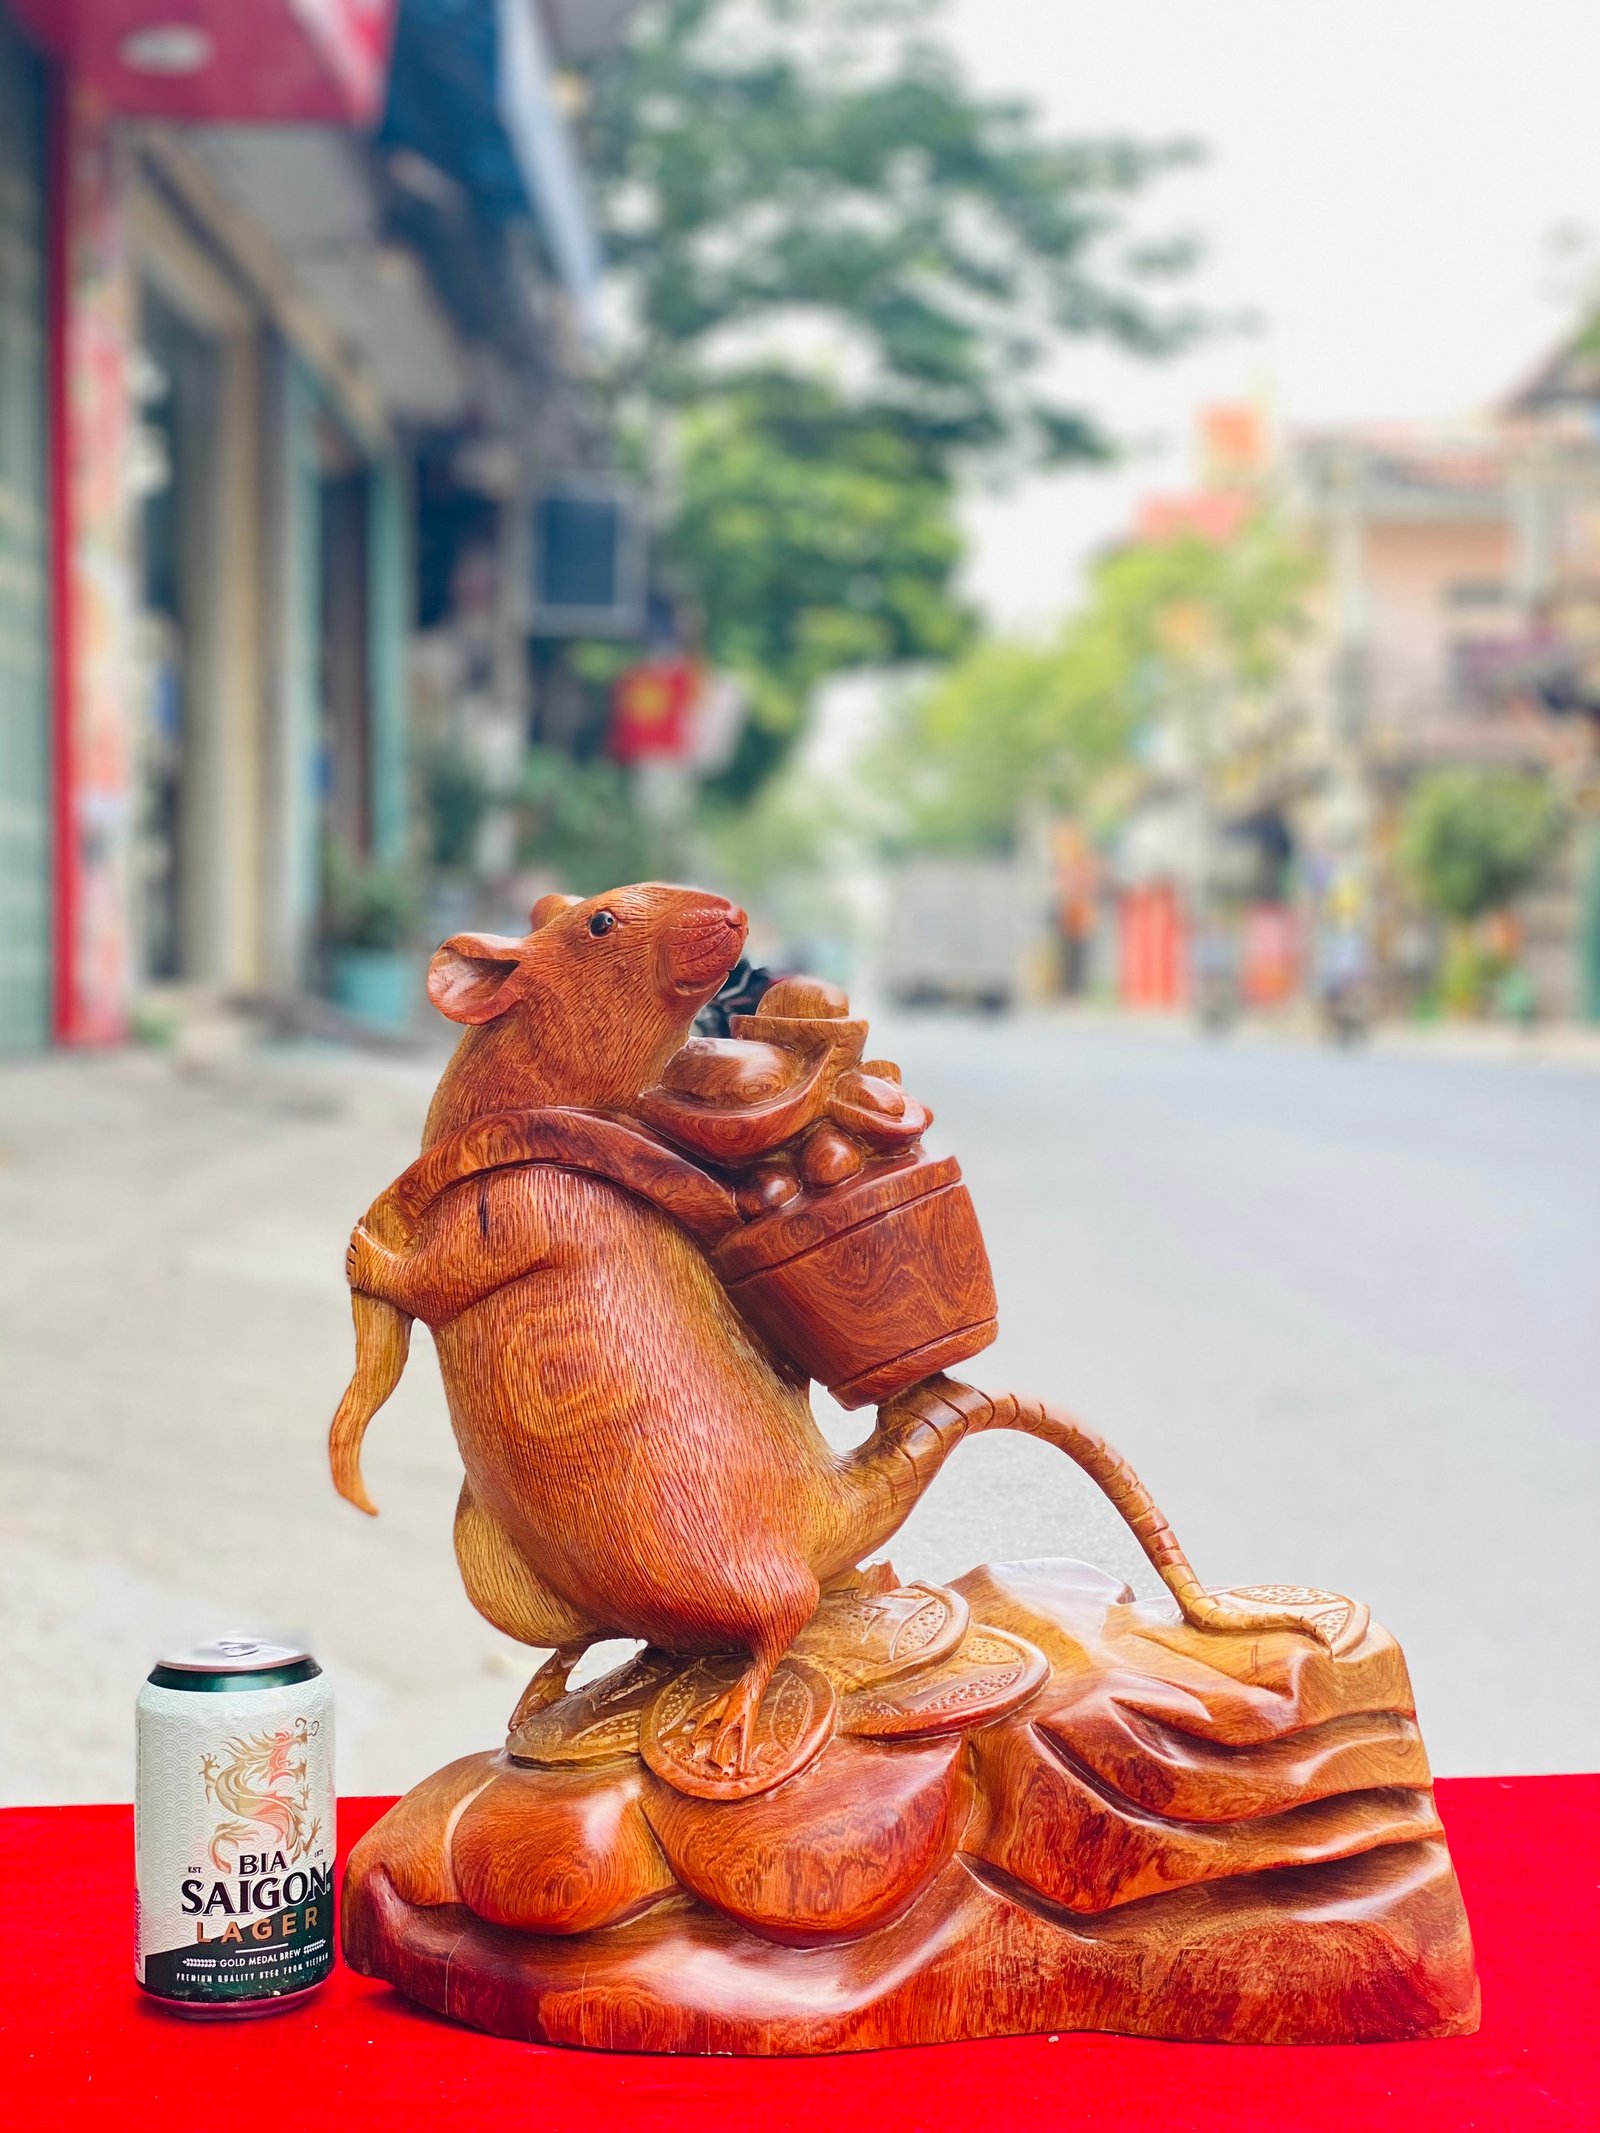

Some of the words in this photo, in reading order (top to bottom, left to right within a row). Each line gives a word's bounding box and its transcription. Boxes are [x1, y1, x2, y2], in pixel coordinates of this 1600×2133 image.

[239, 1850, 289, 1876] BIA
[181, 1862, 328, 1917] SAIGON
[196, 1906, 319, 1944] LAGER
[219, 1958, 246, 1968] GOLD
[248, 1953, 278, 1966] MEDAL
[279, 1947, 302, 1961] BREW
[176, 1972, 213, 1983] PREMIUM
[217, 1972, 255, 1983] QUALITY
[259, 1968, 279, 1979] BEER
[283, 1962, 304, 1975] FROM
